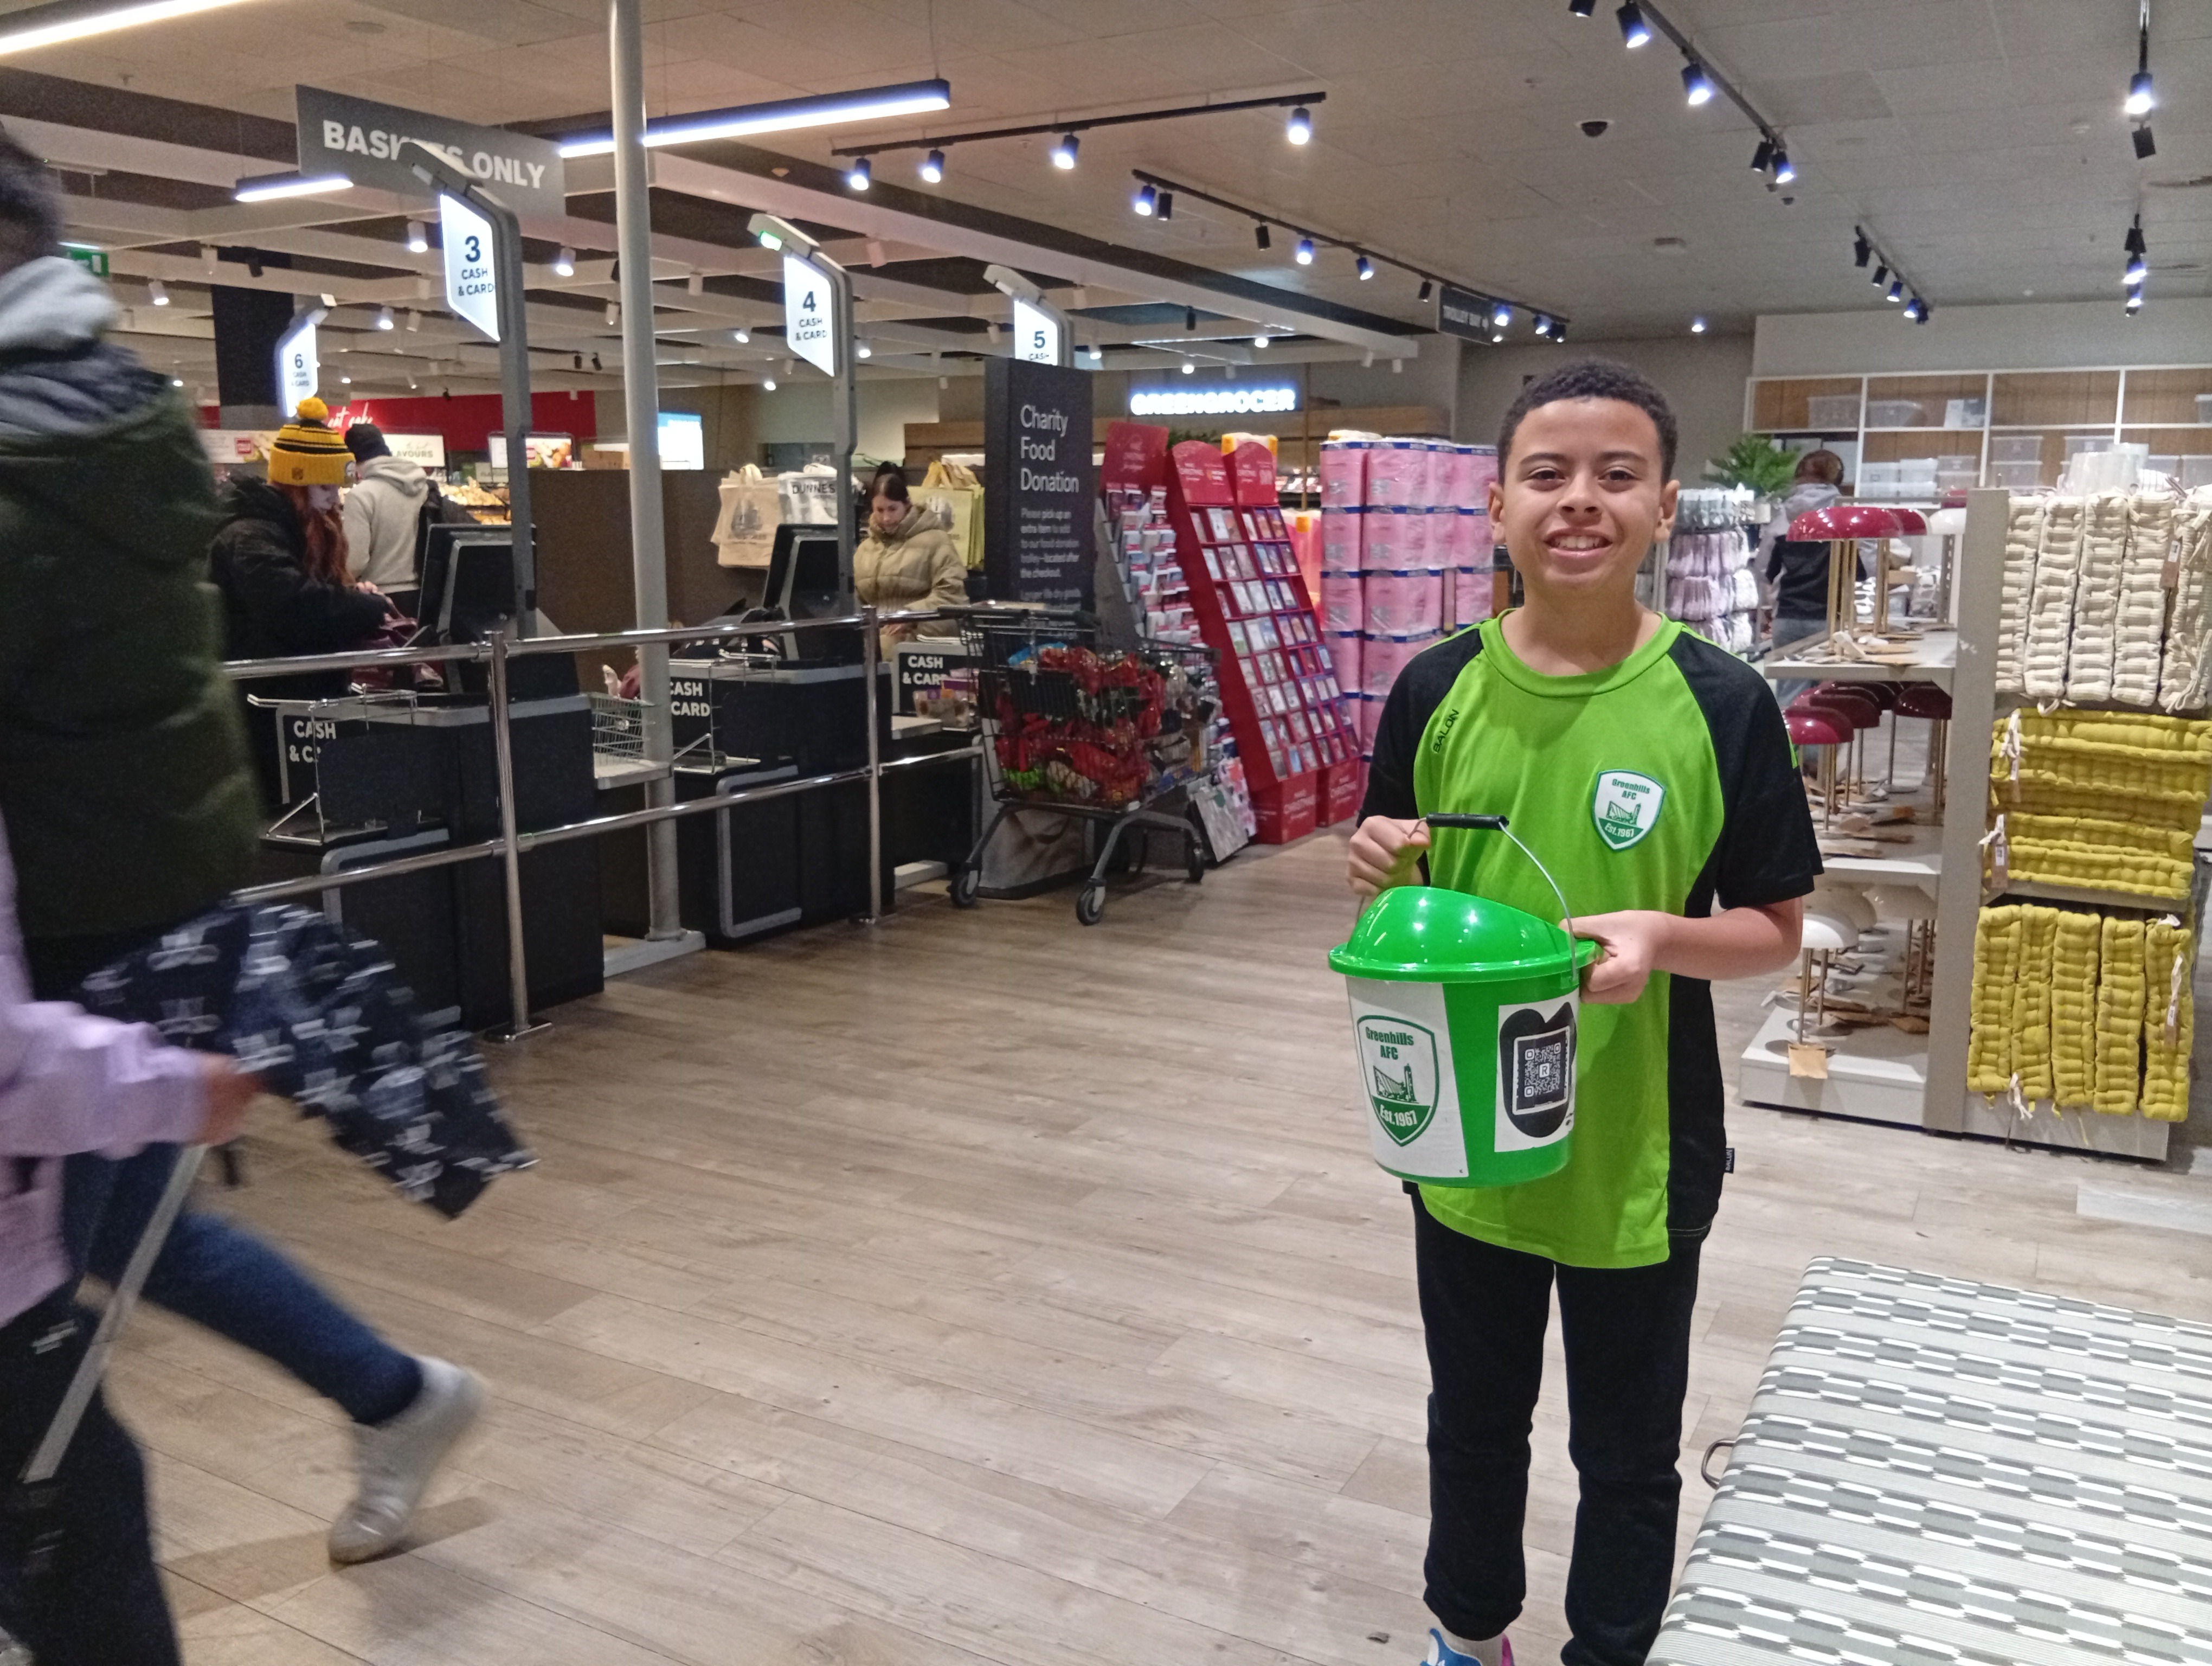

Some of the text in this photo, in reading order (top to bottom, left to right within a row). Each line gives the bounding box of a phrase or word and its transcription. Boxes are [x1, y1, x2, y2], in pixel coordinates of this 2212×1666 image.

[323, 119, 545, 189] BASKS ONLY
[465, 235, 481, 262] 3
[461, 268, 488, 280] CASH
[458, 283, 494, 296] & CARD
[802, 291, 816, 312] 4
[799, 318, 822, 328] CASH
[803, 330, 827, 340] CARD
[1034, 330, 1045, 349] 5
[294, 354, 303, 368] 6
[1020, 404, 1069, 438] Charity
[1020, 436, 1056, 461] Food
[1020, 467, 1079, 492] Donation
[908, 655, 943, 669] CASH
[902, 671, 911, 684] &
[671, 701, 710, 717] CARD
[293, 720, 337, 739] CASH
[1433, 709, 1459, 753] BALON
[289, 745, 300, 762] &
[1612, 778, 1650, 794] Greenhills
[1622, 791, 1637, 799] AFC
[1365, 1026, 1414, 1046] Greenhills
[1380, 1045, 1398, 1060] AFC
